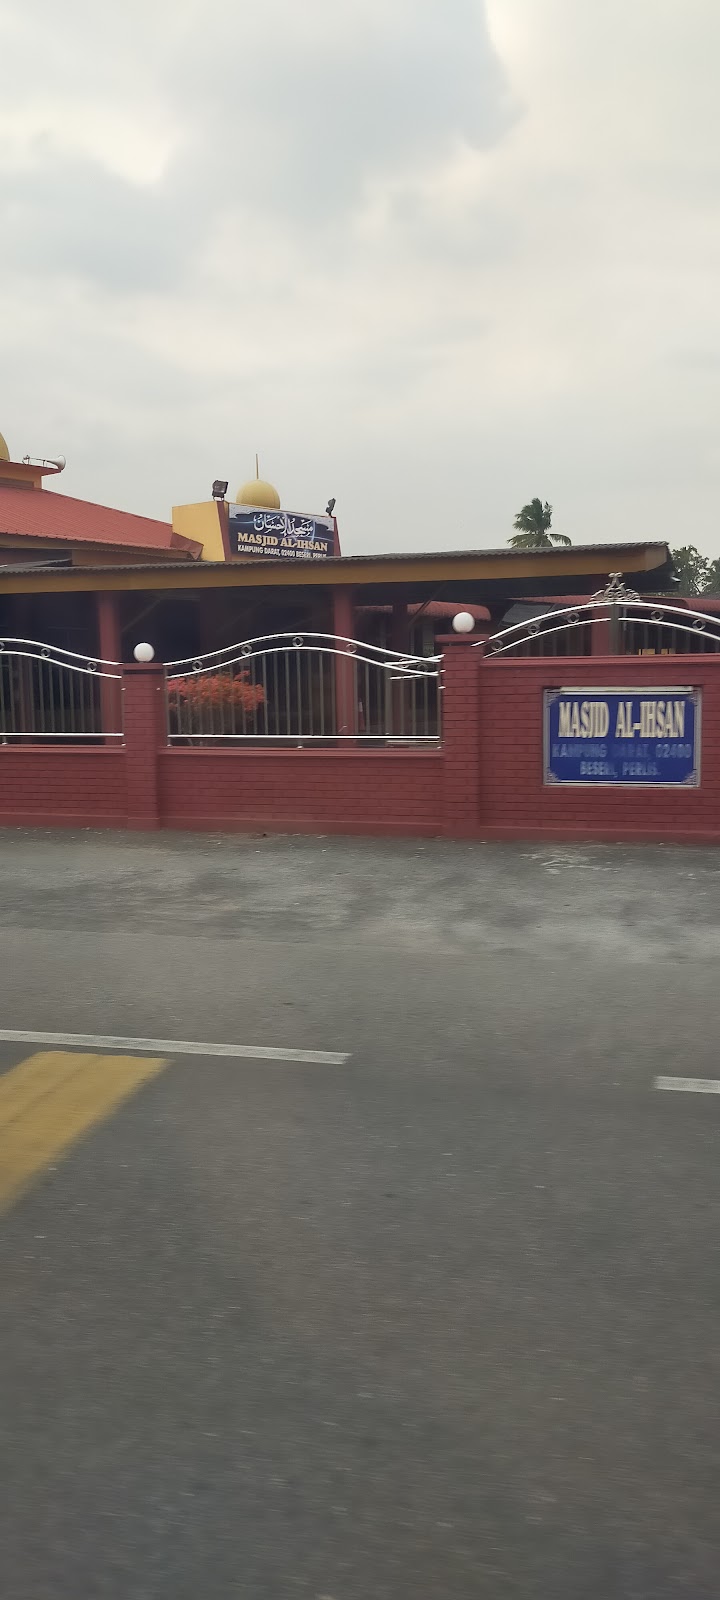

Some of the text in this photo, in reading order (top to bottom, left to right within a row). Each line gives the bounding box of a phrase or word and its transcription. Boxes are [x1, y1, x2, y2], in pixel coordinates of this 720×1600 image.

[237, 532, 328, 551] MASJID AL-IHSAN
[237, 544, 263, 554] KAMPUNG
[558, 701, 685, 738] MASJID AL-IHSAN
